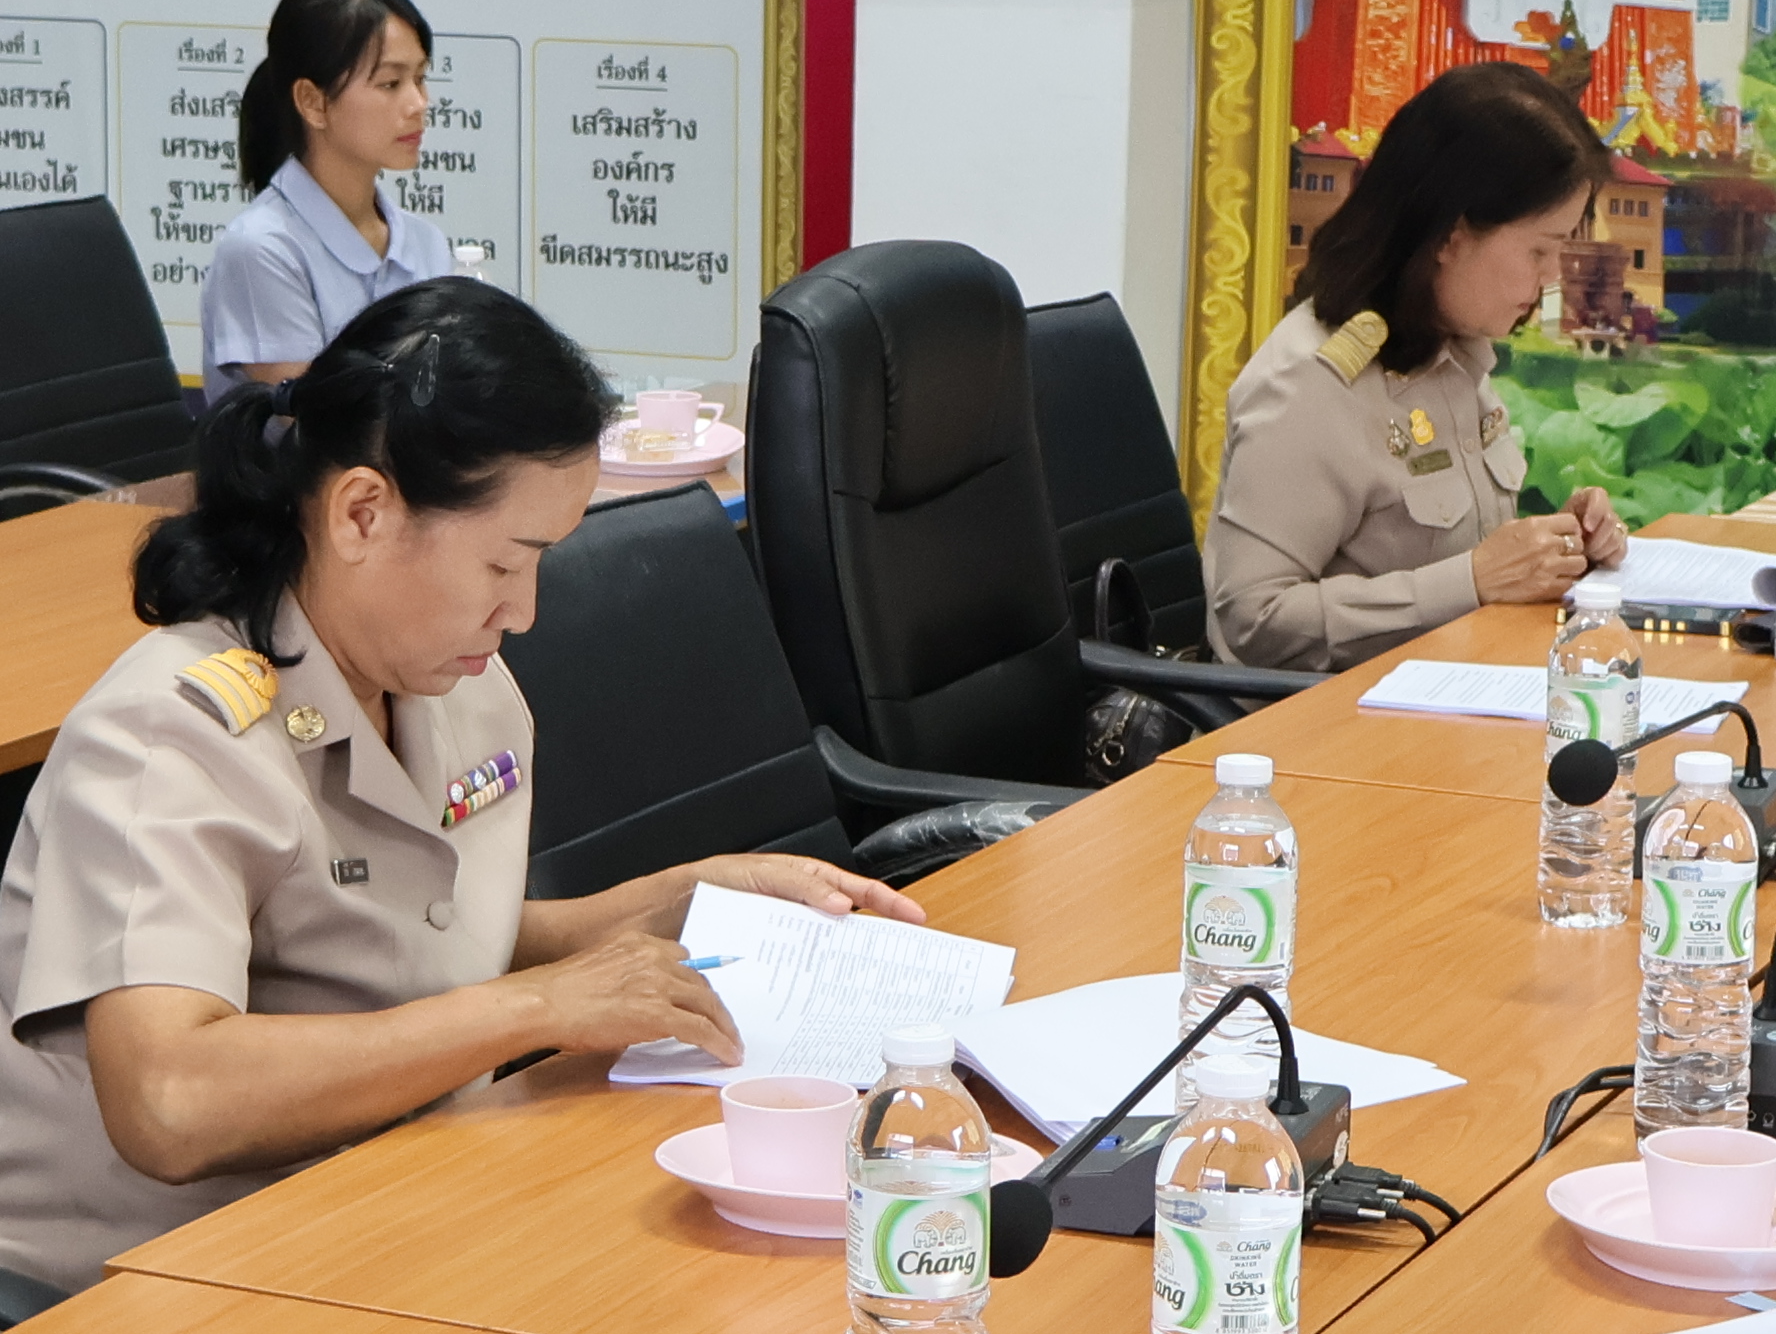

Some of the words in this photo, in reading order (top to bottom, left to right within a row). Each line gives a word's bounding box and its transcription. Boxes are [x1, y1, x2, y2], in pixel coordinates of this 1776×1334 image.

[177, 37, 227, 64] เรื่องที่
[234, 48, 244, 64] 2
[597, 54, 649, 81] เรื่องที่
[656, 66, 668, 83] 4
[170, 87, 242, 117] ส่งเสริ
[572, 108, 698, 141] เสริมสร้าง
[162, 137, 238, 170] เศรษฐ
[592, 151, 675, 183] องค์กร
[396, 178, 444, 214] ให้มี
[607, 188, 657, 226] ให้มี
[540, 234, 729, 285] ขีดสมรรถนะสูง
[1547, 721, 1581, 741] hang
[1194, 923, 1257, 952] Chang
[1237, 1240, 1272, 1253] Chang
[897, 1250, 977, 1275] Chang
[1224, 1280, 1265, 1297] ช้าง
